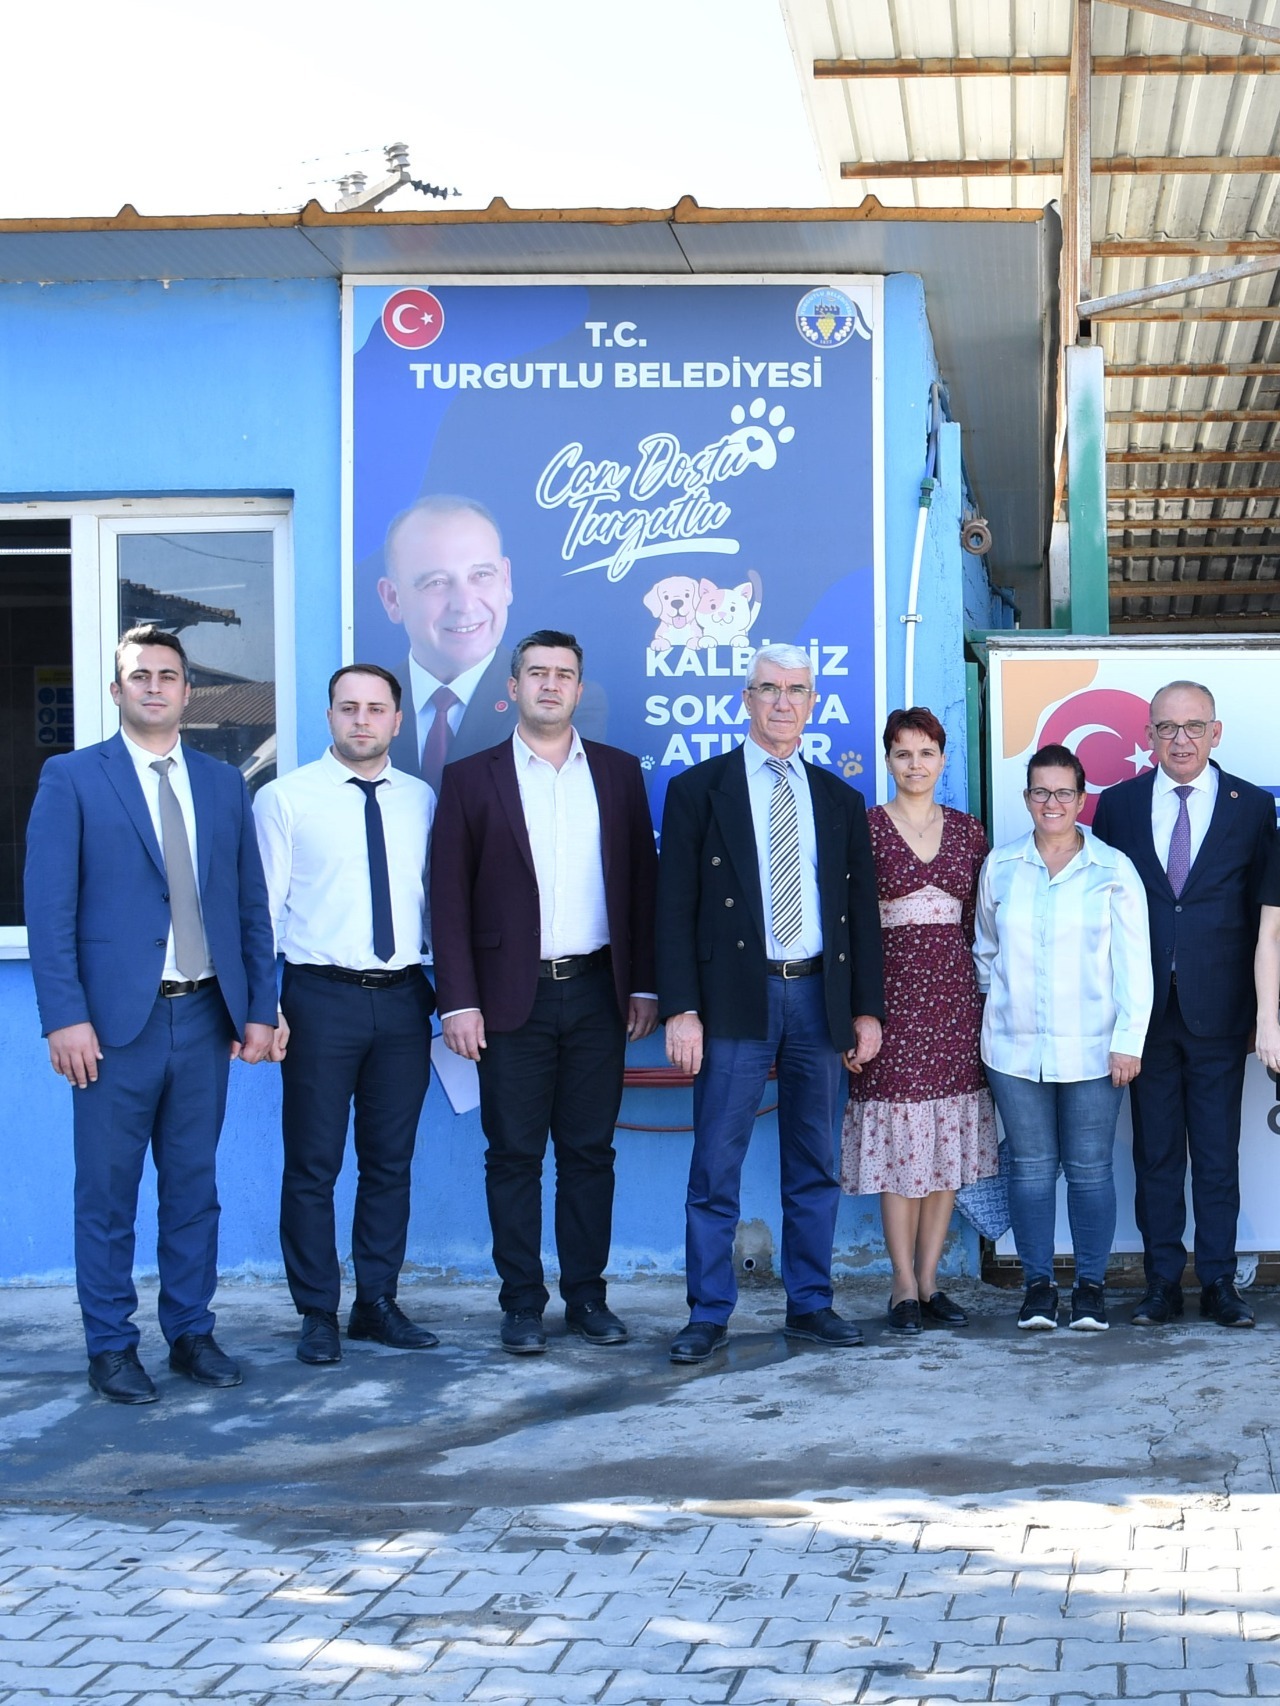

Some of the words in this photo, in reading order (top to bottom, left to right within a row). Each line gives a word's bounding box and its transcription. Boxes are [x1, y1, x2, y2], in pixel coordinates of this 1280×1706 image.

[585, 321, 647, 348] T.C.
[409, 362, 601, 389] TURGUTLU
[614, 355, 822, 388] BELEDİYESİ
[536, 441, 631, 509] Can
[561, 486, 732, 582] Turgutlu
[660, 733, 832, 766] ATIR
